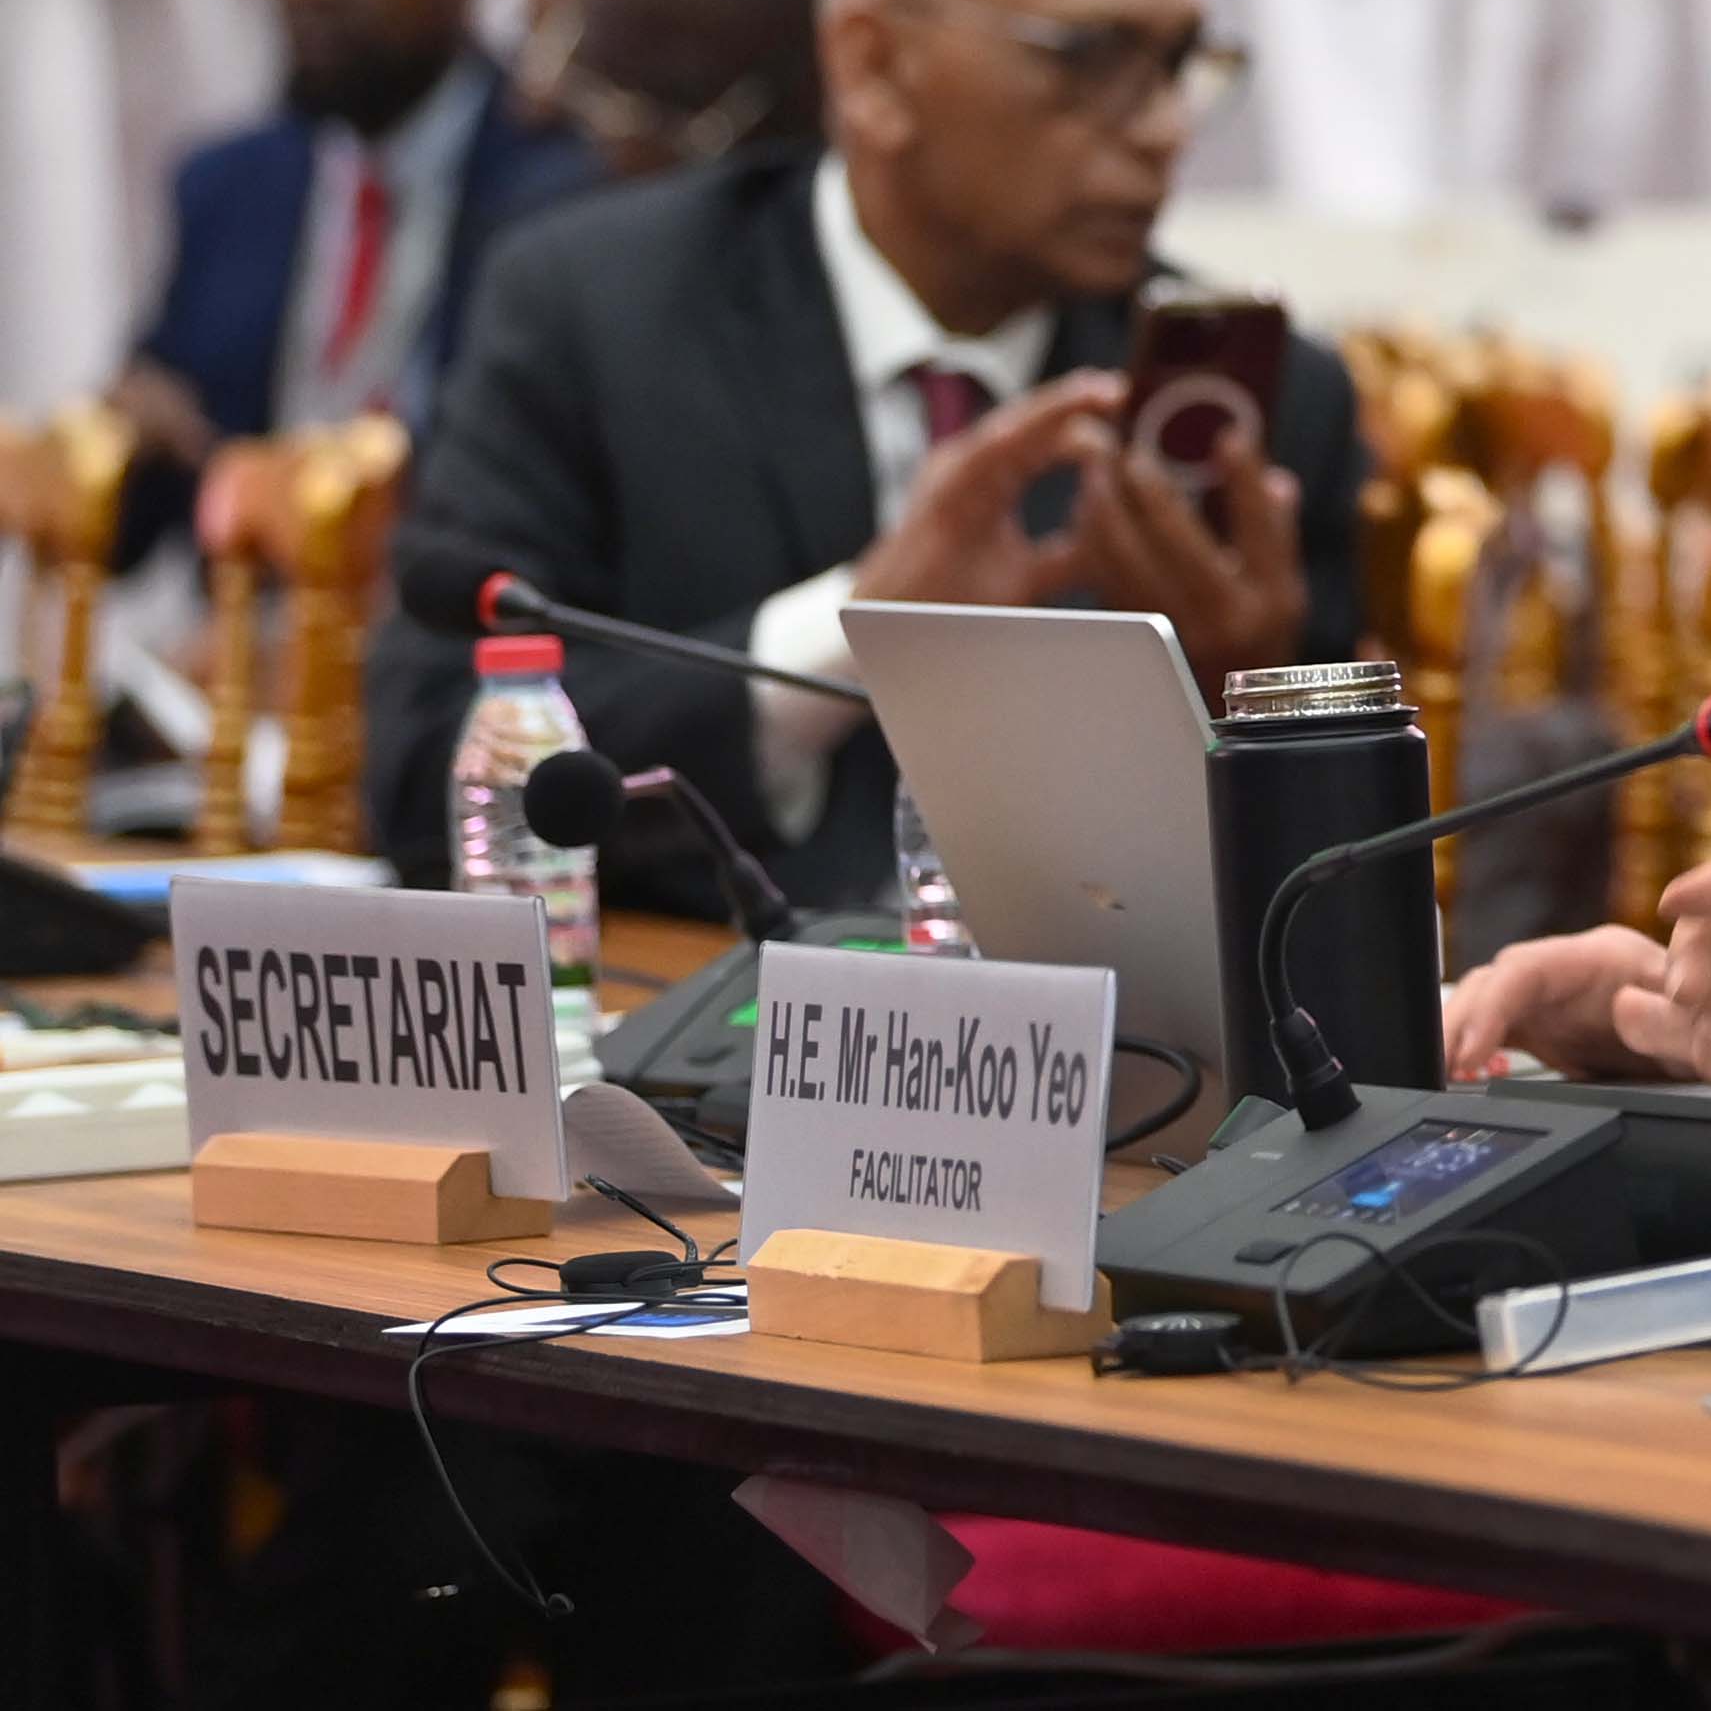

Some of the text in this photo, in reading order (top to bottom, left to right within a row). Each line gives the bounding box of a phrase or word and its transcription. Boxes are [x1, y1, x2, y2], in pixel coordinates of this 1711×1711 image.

[197, 945, 528, 1095] SECRETARIAT
[765, 1001, 1086, 1127] H.E. Mr Han-Koo Yeo
[849, 1148, 983, 1212] FACILITATOR
